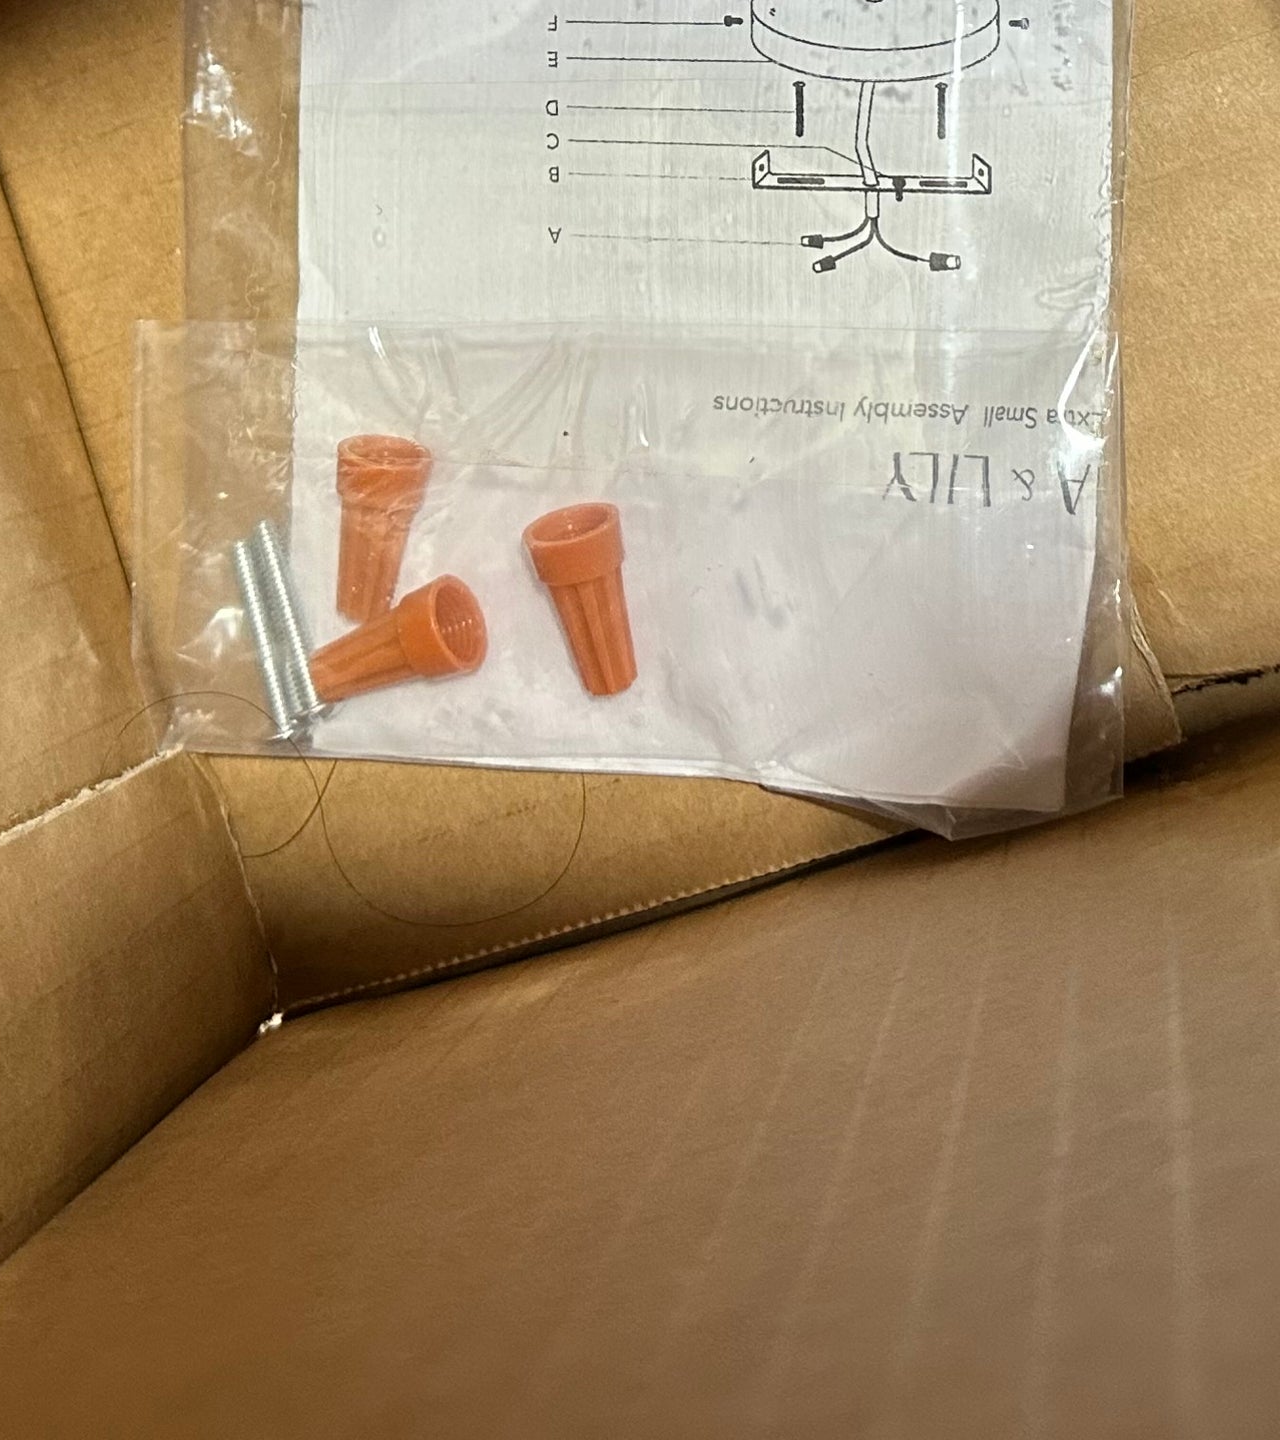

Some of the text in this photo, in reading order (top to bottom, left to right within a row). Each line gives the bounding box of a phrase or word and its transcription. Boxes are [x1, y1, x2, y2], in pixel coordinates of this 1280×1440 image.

[547, 15, 558, 31] F
[547, 51, 558, 68] E
[545, 100, 559, 116] D
[546, 133, 560, 150] C
[548, 166, 559, 183] B
[548, 227, 562, 244] A
[712, 395, 846, 423] Instructions
[853, 395, 969, 426] Assembly
[985, 404, 1038, 430] Small
[882, 451, 992, 508] LILY
[1012, 469, 1036, 502] &
